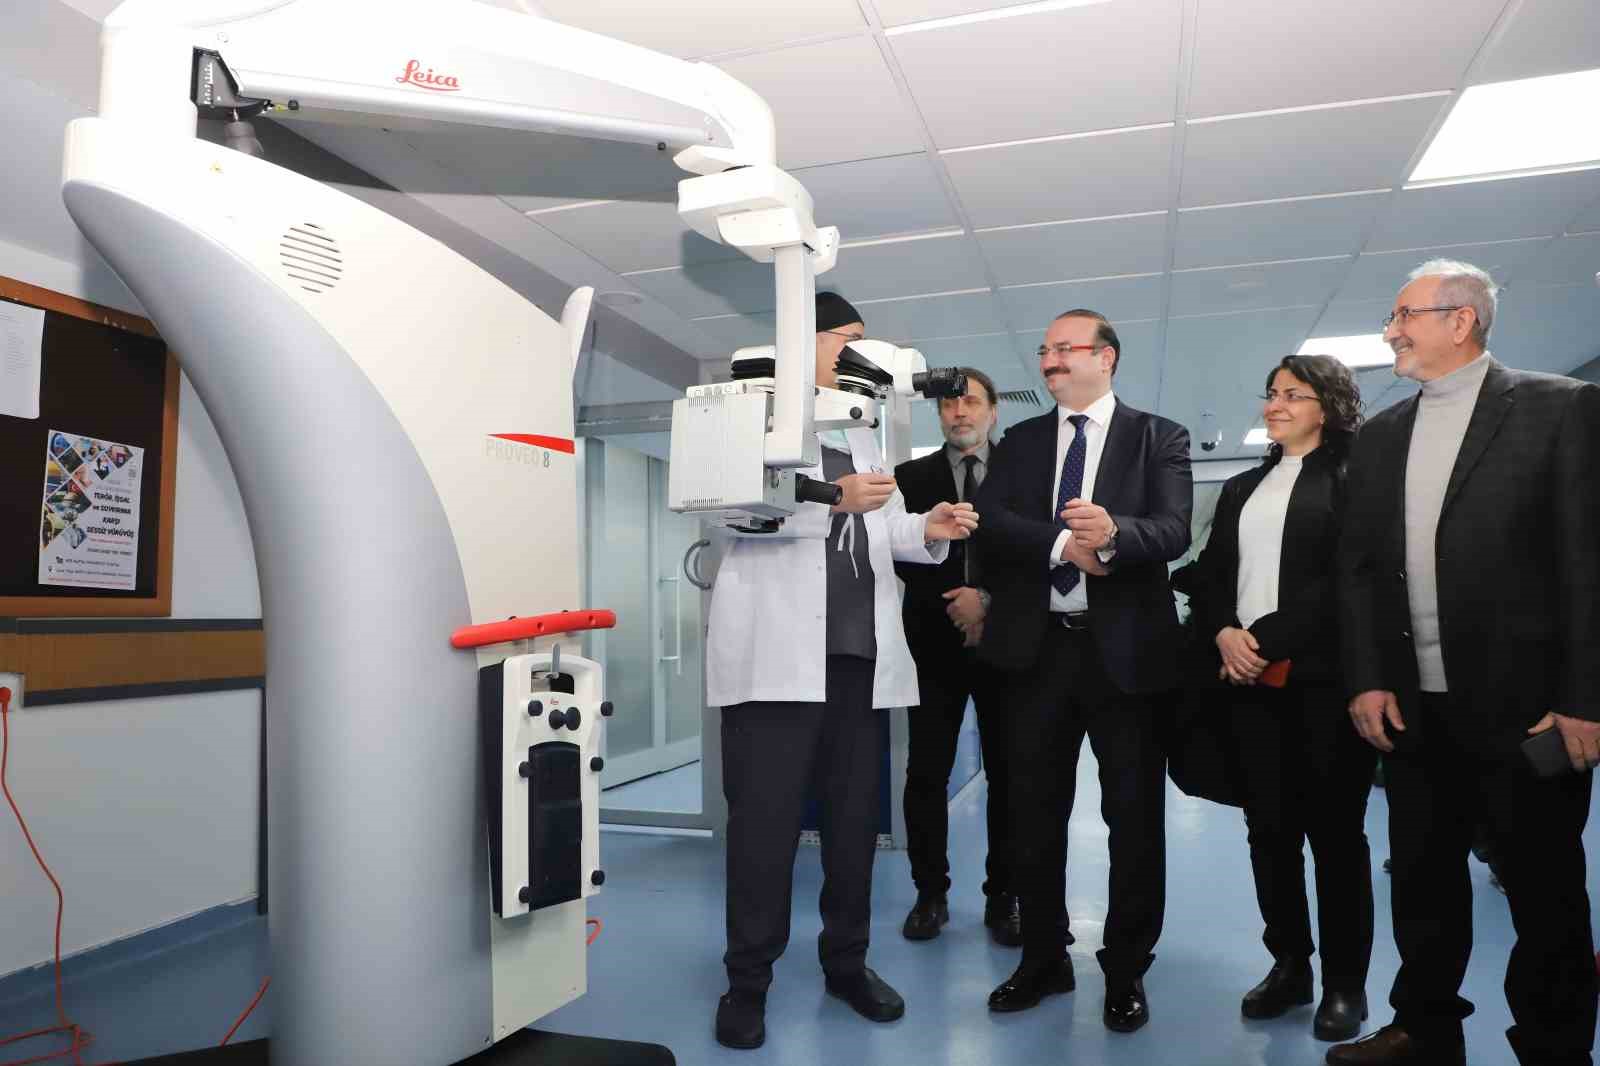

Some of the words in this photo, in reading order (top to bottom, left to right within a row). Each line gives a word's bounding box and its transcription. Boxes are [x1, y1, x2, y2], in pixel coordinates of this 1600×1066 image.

[396, 59, 460, 90] Leica
[485, 438, 540, 468] PROVEO
[543, 450, 550, 468] 8
